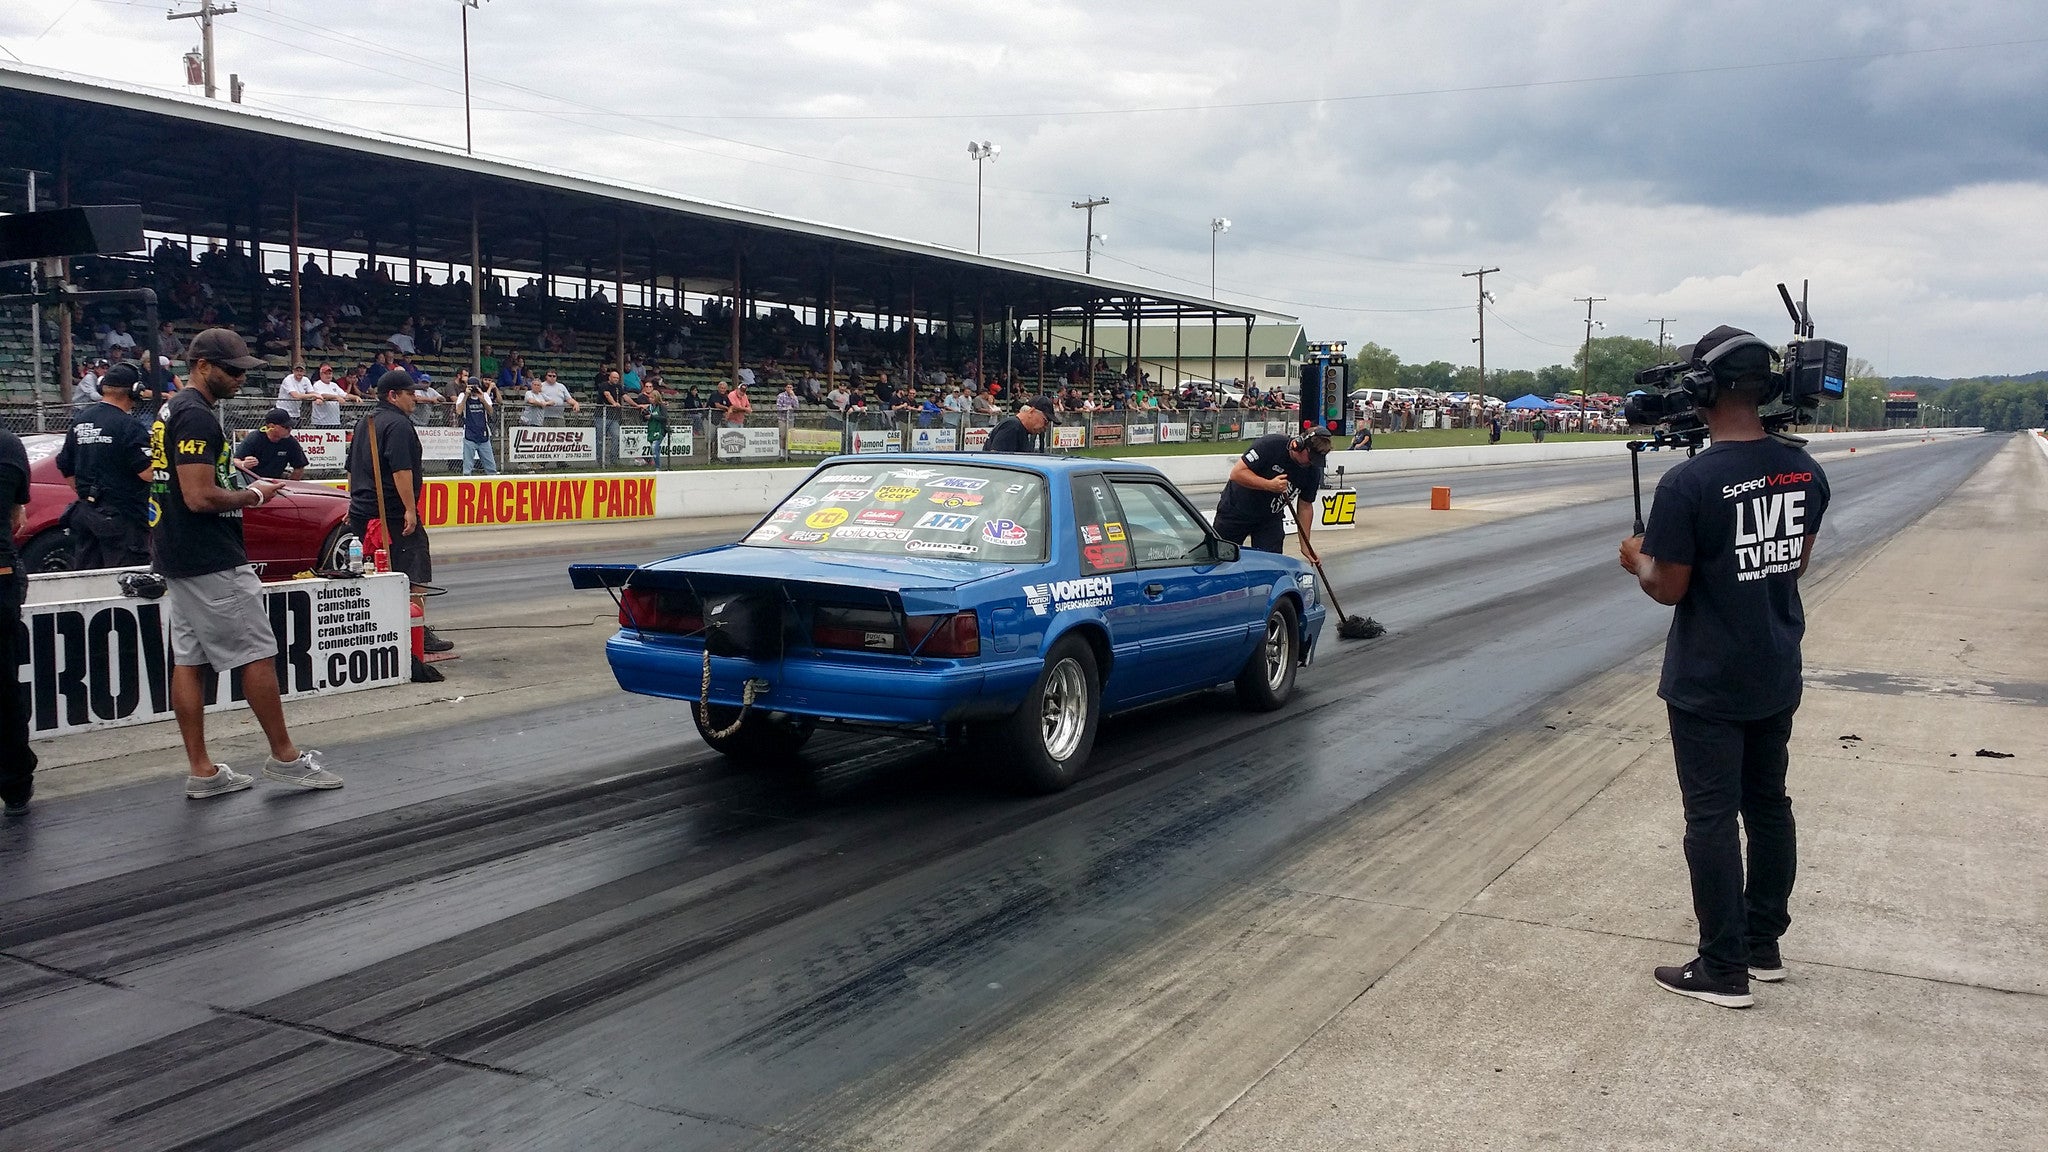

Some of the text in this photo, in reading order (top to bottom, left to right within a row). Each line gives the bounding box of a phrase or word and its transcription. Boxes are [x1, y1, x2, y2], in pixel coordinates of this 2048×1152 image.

[326, 433, 342, 443] Inc.
[521, 430, 583, 442] LINDSEY
[965, 437, 987, 445] OUTBAC
[178, 440, 206, 454] 147
[532, 442, 592, 452] automotive
[857, 439, 883, 448] Diamond
[826, 490, 869, 498] MSD
[879, 486, 919, 494] Motive
[1005, 483, 1024, 494] 2
[457, 481, 587, 524] RACEWAY
[593, 479, 654, 518] PARK
[920, 514, 972, 529] AFR
[1735, 491, 1806, 546] LIVE
[836, 528, 910, 540] wilwood
[986, 519, 1014, 539] VP
[1735, 537, 1804, 570] TV REW
[317, 587, 361, 600] clutches
[1048, 577, 1113, 602] VORTECH
[317, 598, 370, 613] camshafts
[1029, 597, 1050, 605] VORTECH
[317, 610, 371, 625] valve train
[317, 622, 378, 638] crankshafts
[318, 631, 399, 651] connecting rods
[319, 645, 400, 689] .com
